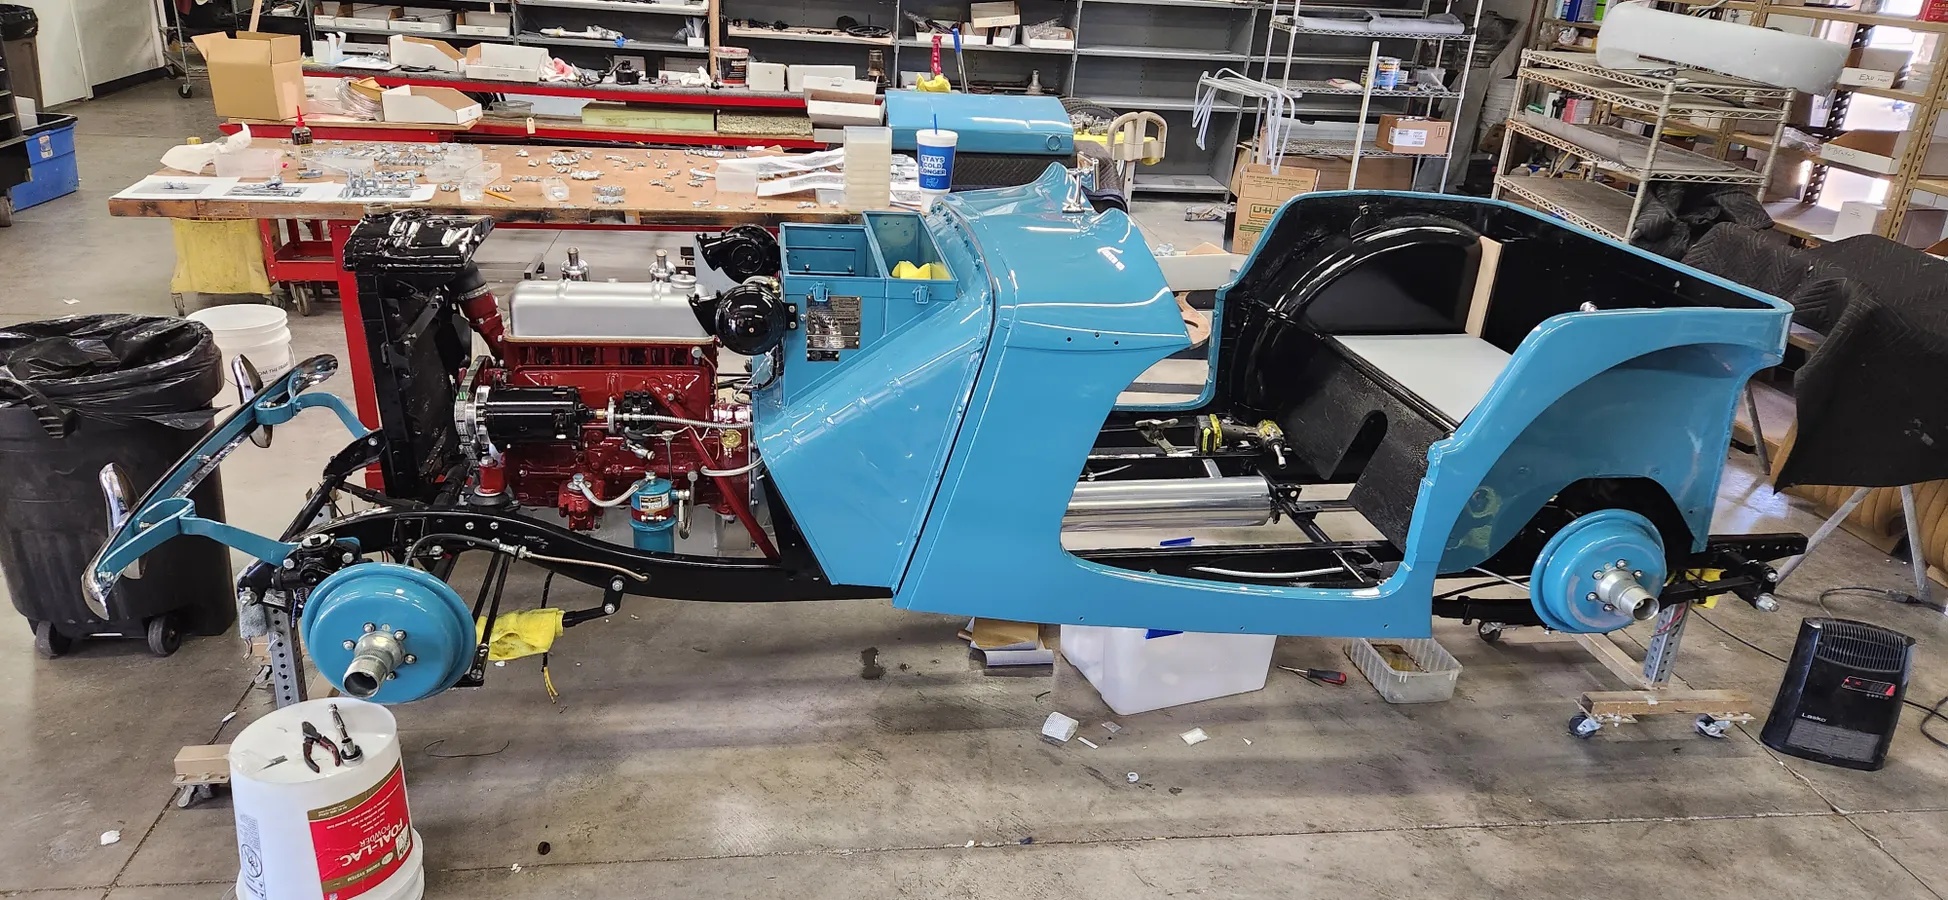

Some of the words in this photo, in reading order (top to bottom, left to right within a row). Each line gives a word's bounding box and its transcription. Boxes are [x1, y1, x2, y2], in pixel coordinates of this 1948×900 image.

[921, 155, 945, 163] STAYS
[1801, 712, 1827, 723] Lasko
[339, 817, 403, 867] FOAL-LAC
[360, 823, 391, 848] POWDER
